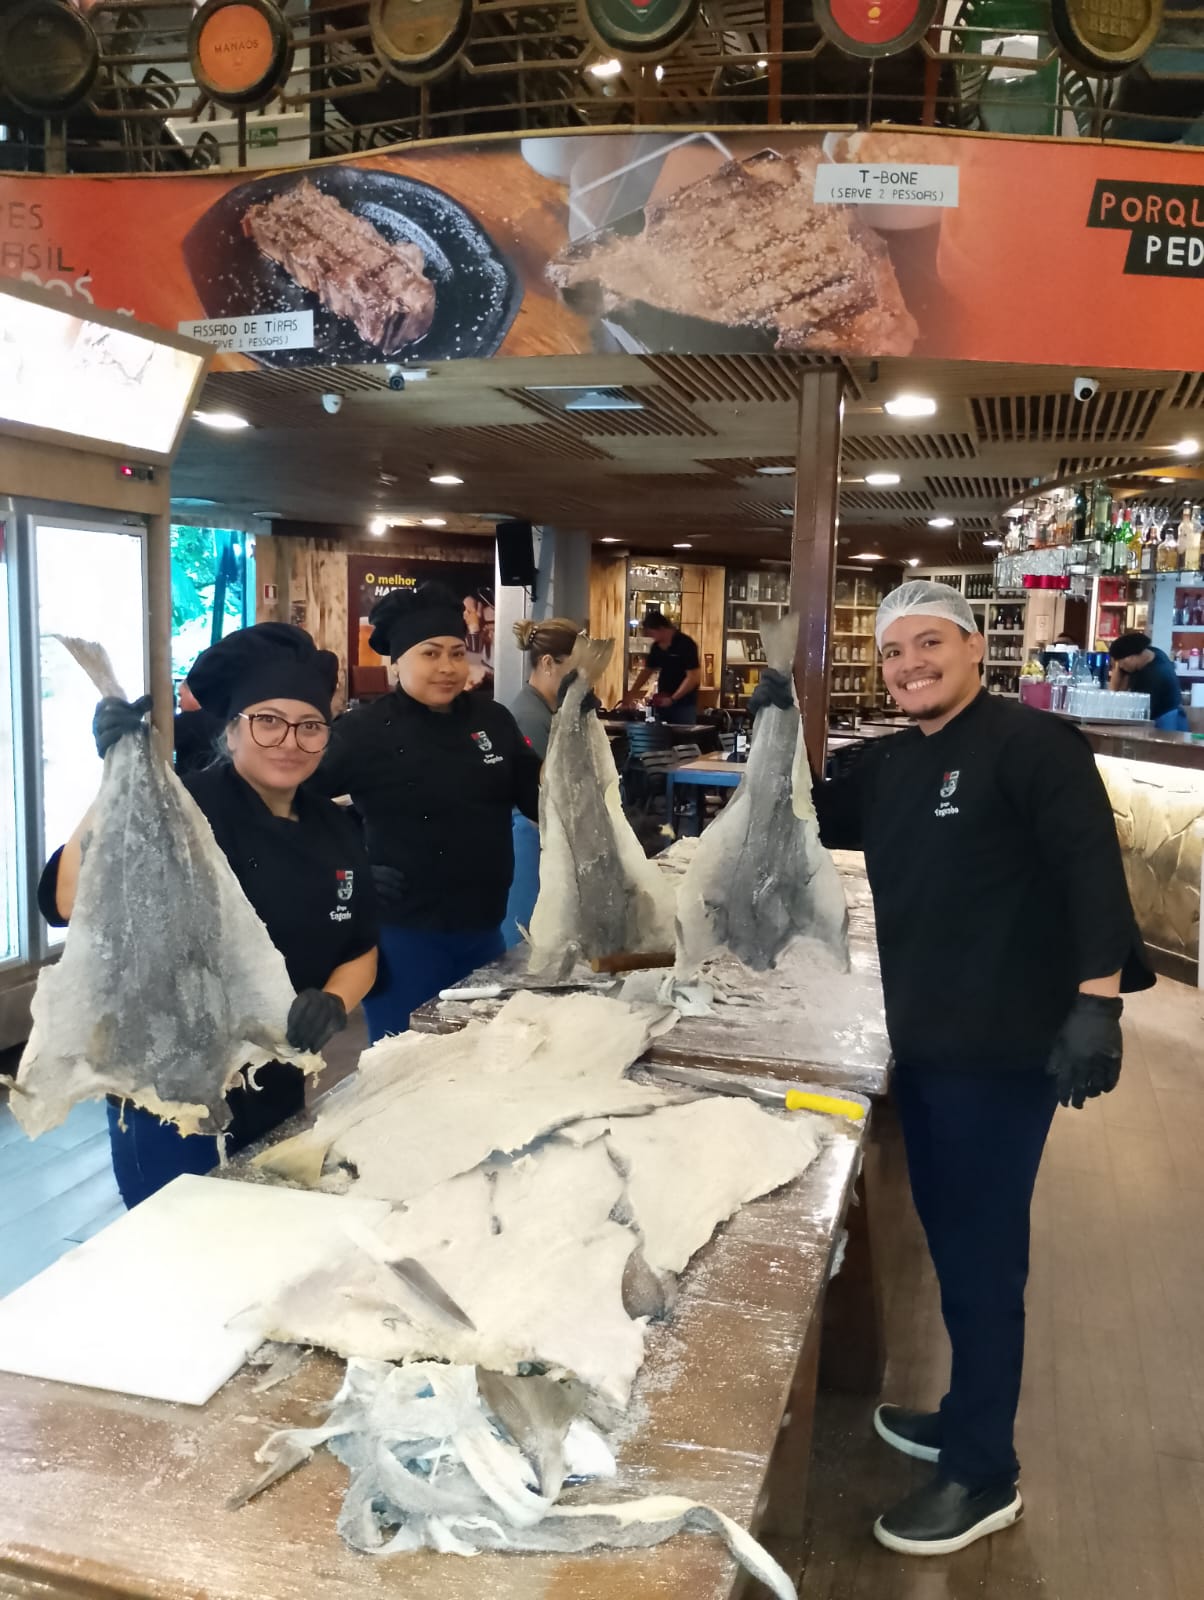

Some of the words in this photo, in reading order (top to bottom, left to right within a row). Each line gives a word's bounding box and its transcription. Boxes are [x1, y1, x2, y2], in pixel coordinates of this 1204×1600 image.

[831, 187, 872, 199] (SERVE
[880, 188, 885, 199] 2
[892, 188, 944, 201] PESSOAS)
[0, 201, 44, 230] ES
[1145, 235, 1204, 267] PED
[193, 323, 237, 337] ASSADO
[244, 322, 257, 334] DE
[365, 572, 375, 584] O
[377, 574, 417, 586] melhor
